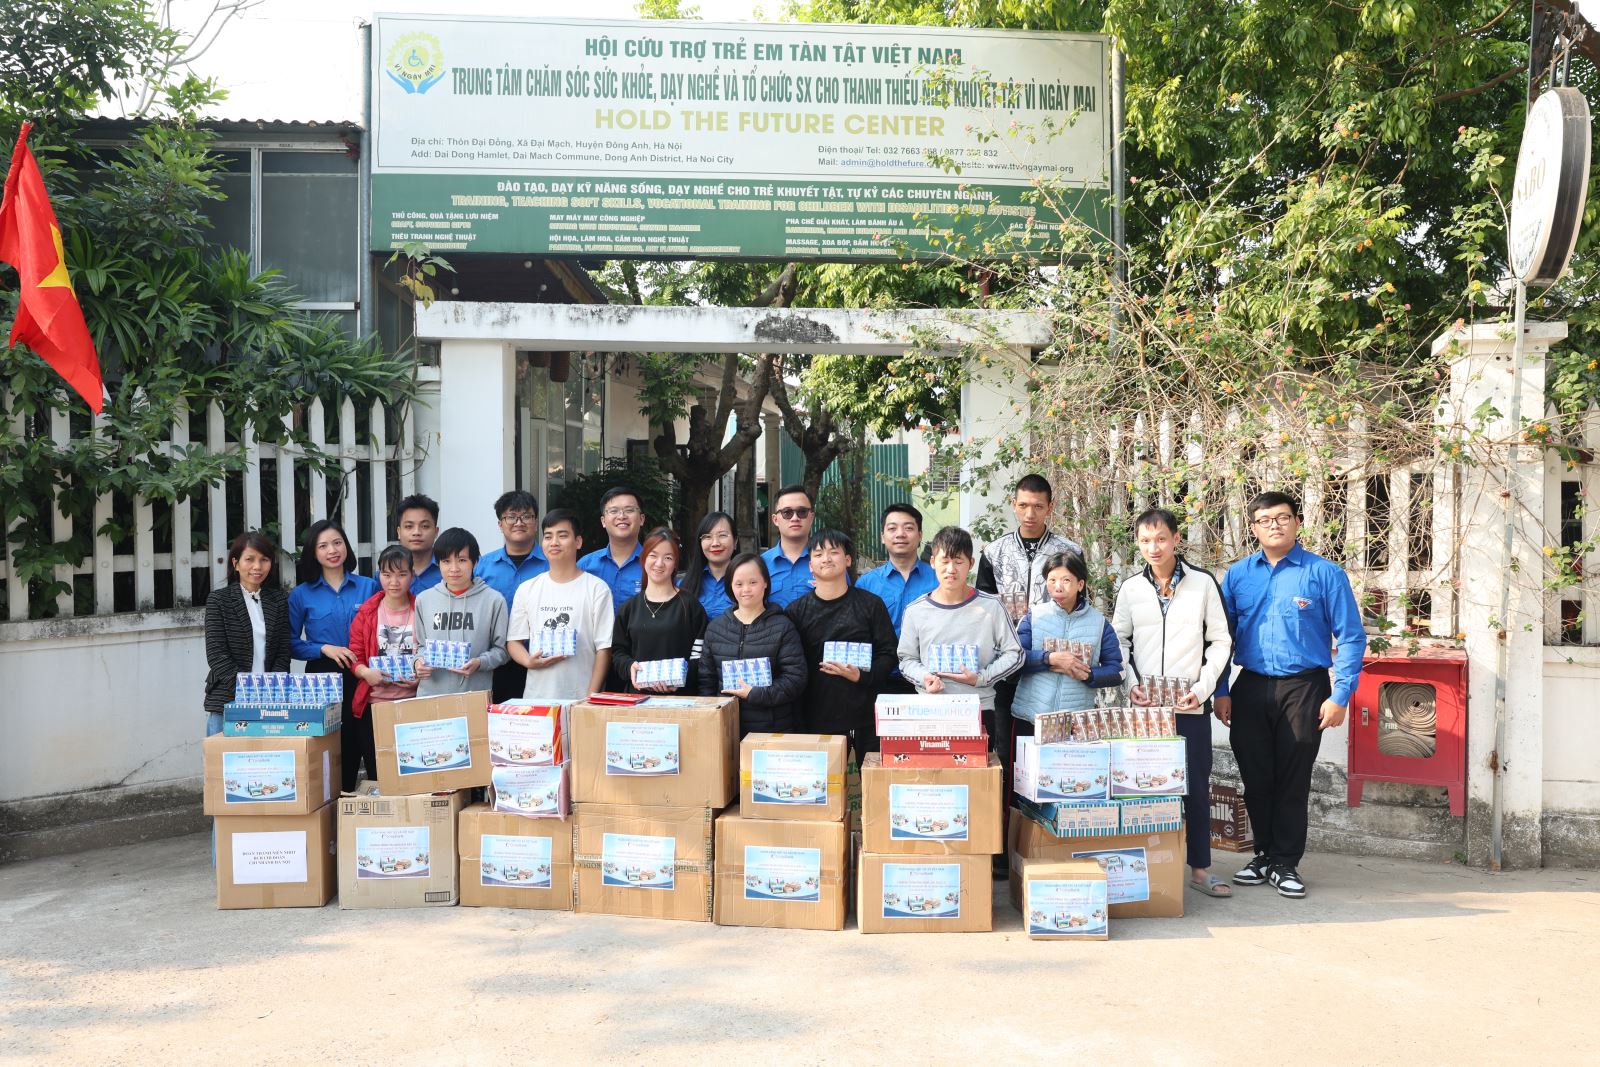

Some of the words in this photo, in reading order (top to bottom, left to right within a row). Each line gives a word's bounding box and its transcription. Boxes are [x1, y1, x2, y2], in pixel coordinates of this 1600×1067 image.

[585, 35, 617, 60] HỘI
[624, 36, 663, 57] CỨU
[670, 40, 706, 62] TRỢ
[712, 37, 747, 60] TRẺ
[754, 43, 783, 60] EM
[789, 41, 826, 62] TÀN
[832, 42, 866, 66] TẬT
[872, 43, 912, 67] VIỆT
[917, 47, 962, 65] NAM
[452, 67, 492, 95] TRUNG
[496, 62, 522, 95] TÂM
[526, 64, 562, 97] CHĂM
[565, 65, 590, 98] SÓC
[593, 66, 618, 99] SỨC
[660, 73, 684, 106] DẠY
[687, 65, 719, 101] NGHỀ
[723, 69, 739, 101] VÀ
[743, 65, 757, 102] TỔ
[761, 70, 792, 103] CHỨC
[796, 77, 812, 103] SX
[815, 77, 839, 104] CHO
[842, 77, 882, 105] THANH
[885, 70, 919, 106] THIẾU
[1025, 77, 1036, 109] VÌ
[1039, 78, 1070, 111] NGÀY
[1073, 85, 1096, 112] MAI
[595, 109, 671, 130] HOLD
[680, 110, 728, 131] THE
[738, 112, 834, 134] FUTURE
[844, 114, 945, 137] CENTER
[411, 137, 426, 148] Địa
[447, 138, 469, 146] Thôn
[472, 138, 486, 148] Đại
[531, 139, 545, 149] Đại
[547, 140, 573, 150] Mạch,
[575, 140, 603, 150] Huyện
[631, 142, 651, 150] Anh,
[653, 142, 665, 150] Hà
[667, 142, 682, 151] Nội
[818, 145, 838, 154] Điện
[883, 147, 898, 155] 032
[901, 147, 920, 155] 7663
[411, 150, 431, 158] Add:
[434, 150, 449, 158] Dai
[451, 151, 475, 160] Dong
[477, 151, 510, 160] Hamlet,
[513, 151, 527, 160] Dai
[529, 152, 553, 160] Mach
[555, 152, 602, 162] Commune,
[604, 153, 628, 163] Dong
[630, 154, 647, 162] Anh
[650, 154, 683, 163] District,
[686, 155, 698, 163] Ha
[700, 155, 715, 163] Noi
[717, 155, 734, 164] City
[818, 158, 838, 166] Mail:
[953, 160, 984, 168] ebsite:
[497, 180, 521, 192] ĐÀO
[523, 181, 548, 195] TẠO,
[551, 182, 574, 196] DẠY
[577, 182, 592, 194] KỸ
[595, 181, 627, 194] NĂNG
[630, 181, 665, 196] SỐNG,
[668, 185, 690, 197] DẠY
[727, 186, 750, 196] CHO
[753, 184, 774, 196] TRẺ
[777, 185, 819, 198] KHUYẾT
[847, 187, 862, 199] TỰ
[881, 186, 904, 199] CÁC
[907, 187, 951, 200] CHUYÊN
[481, 212, 498, 221] NIỆM
[410, 233, 433, 241] TRANH
[785, 238, 820, 246] MASSAGE,
[441, 612, 474, 630] NBA
[261, 709, 289, 717] Vinamilk
[920, 740, 950, 748] Vinamilk
